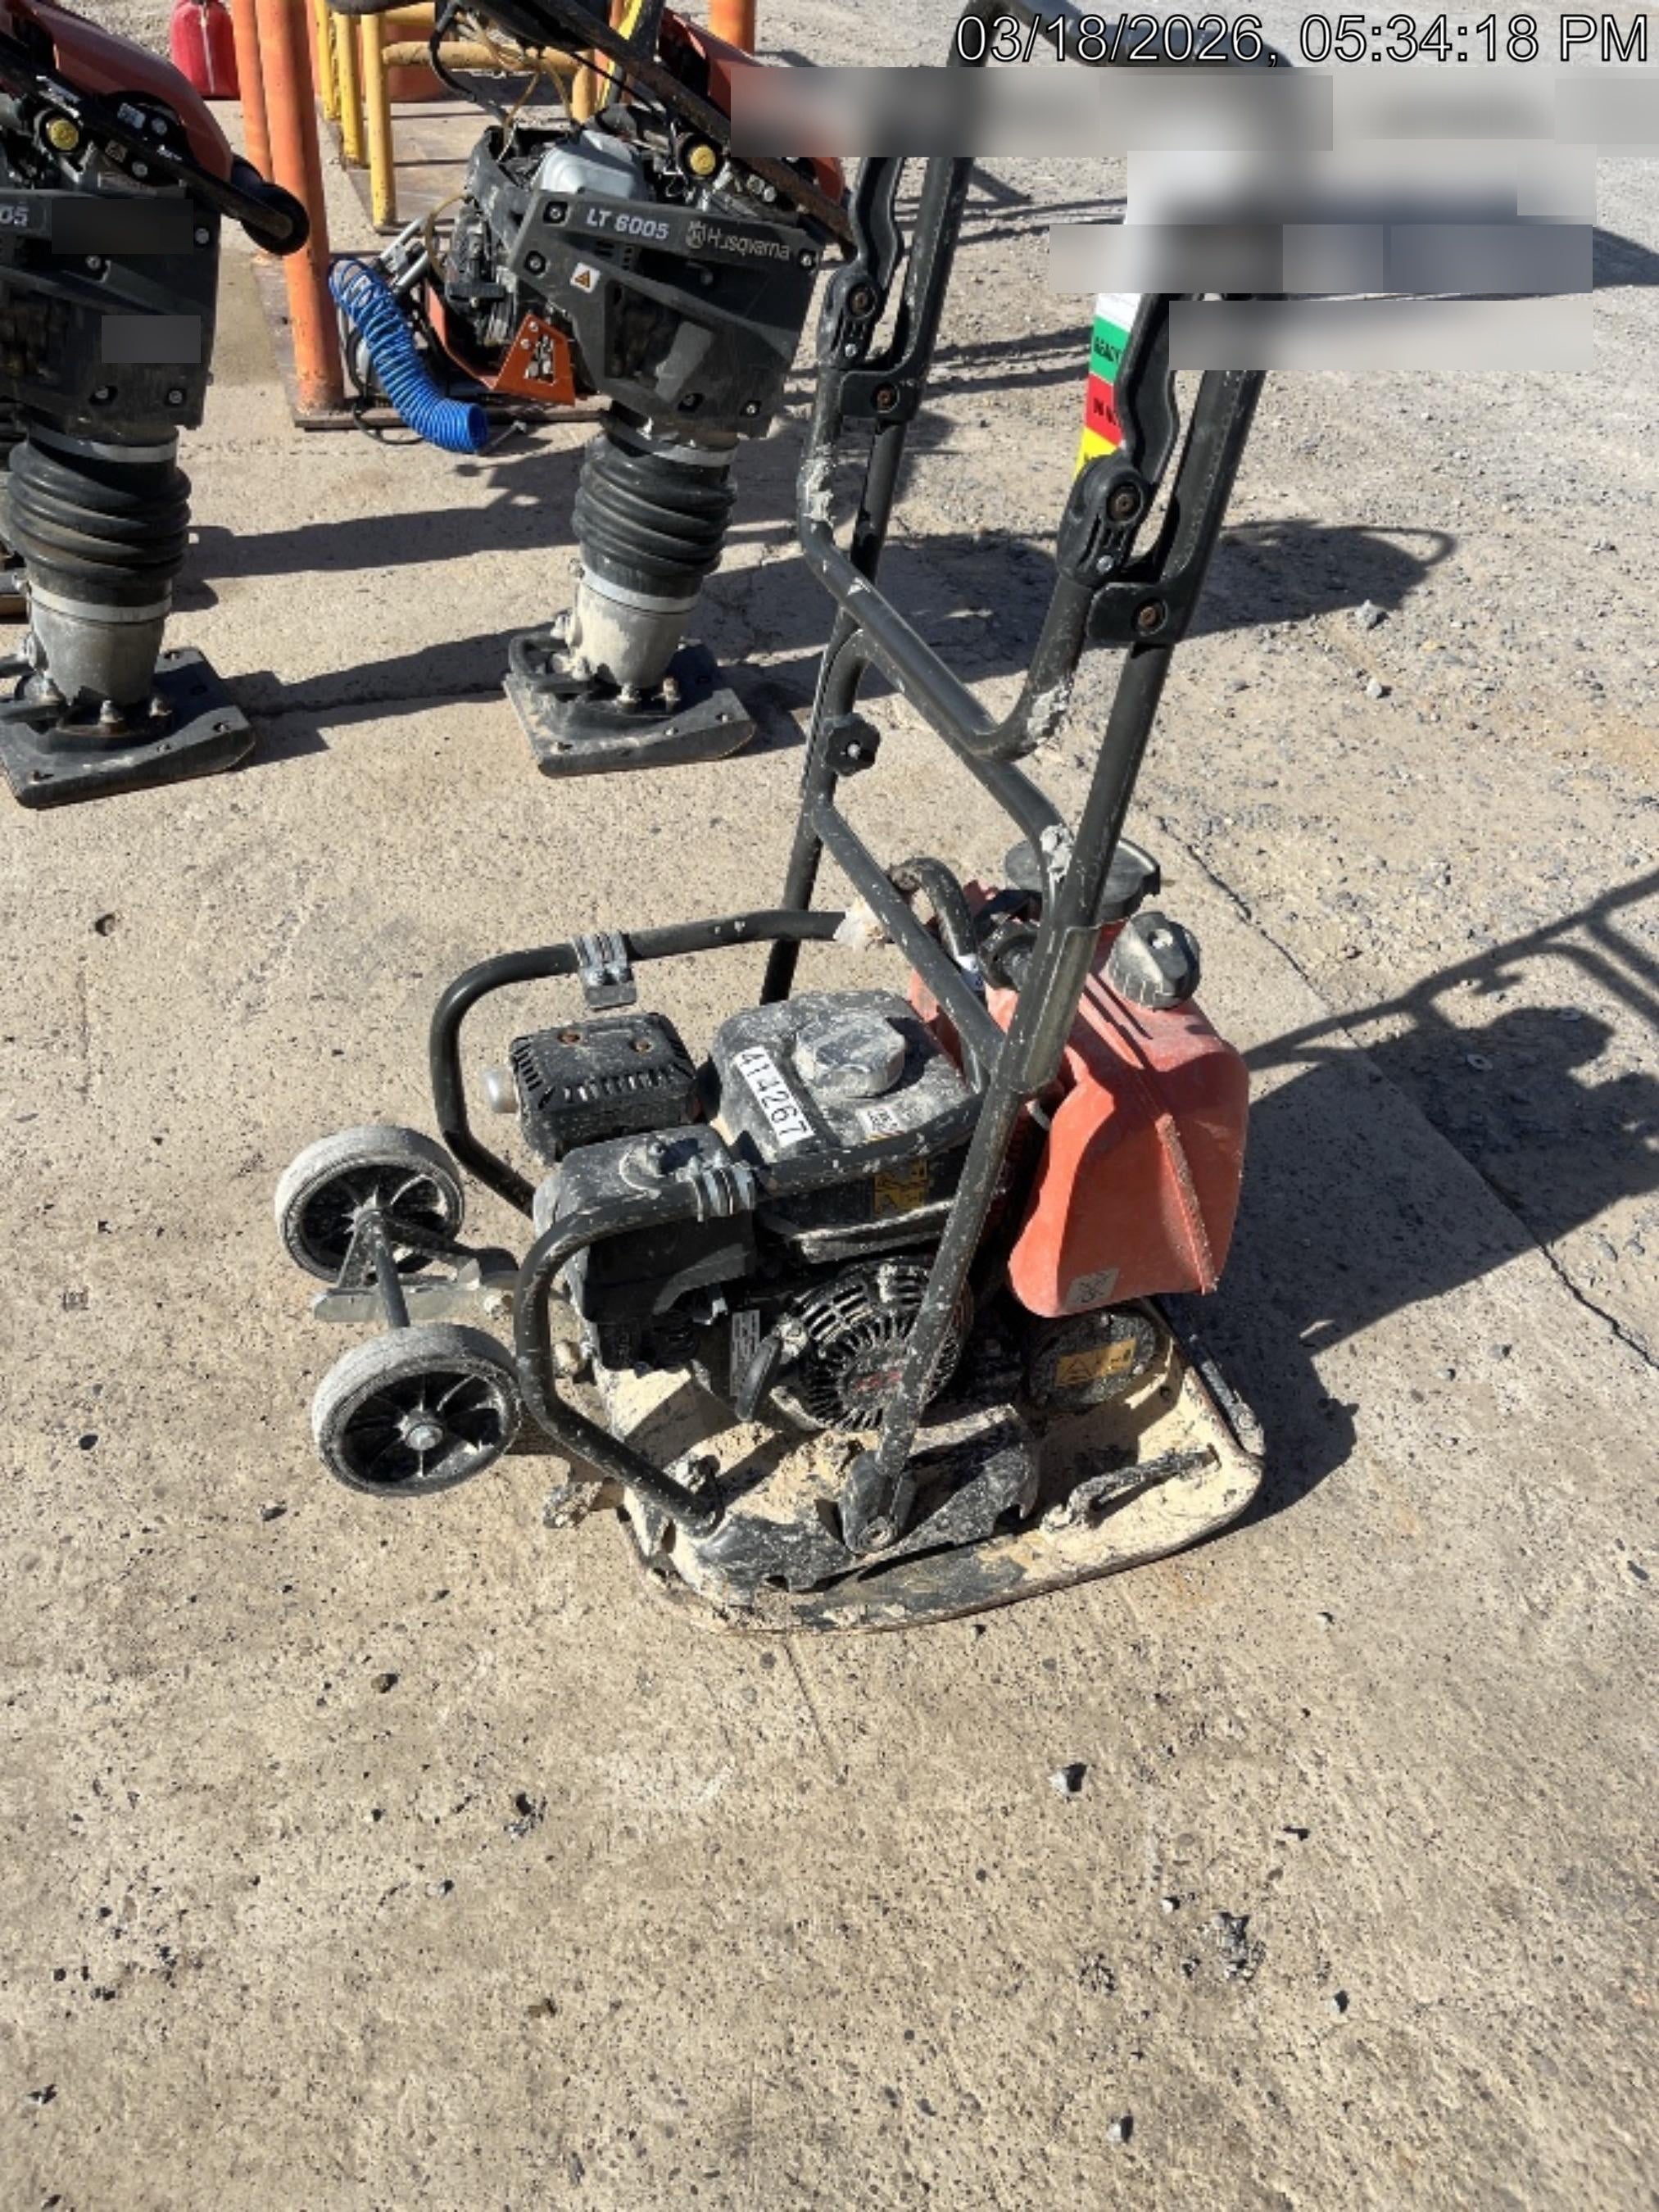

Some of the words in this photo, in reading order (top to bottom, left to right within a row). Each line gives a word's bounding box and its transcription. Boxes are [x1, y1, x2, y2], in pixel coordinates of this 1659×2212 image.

[587, 208, 612, 229] LT
[615, 215, 669, 240] 6005
[740, 1053, 807, 1136] 414267
